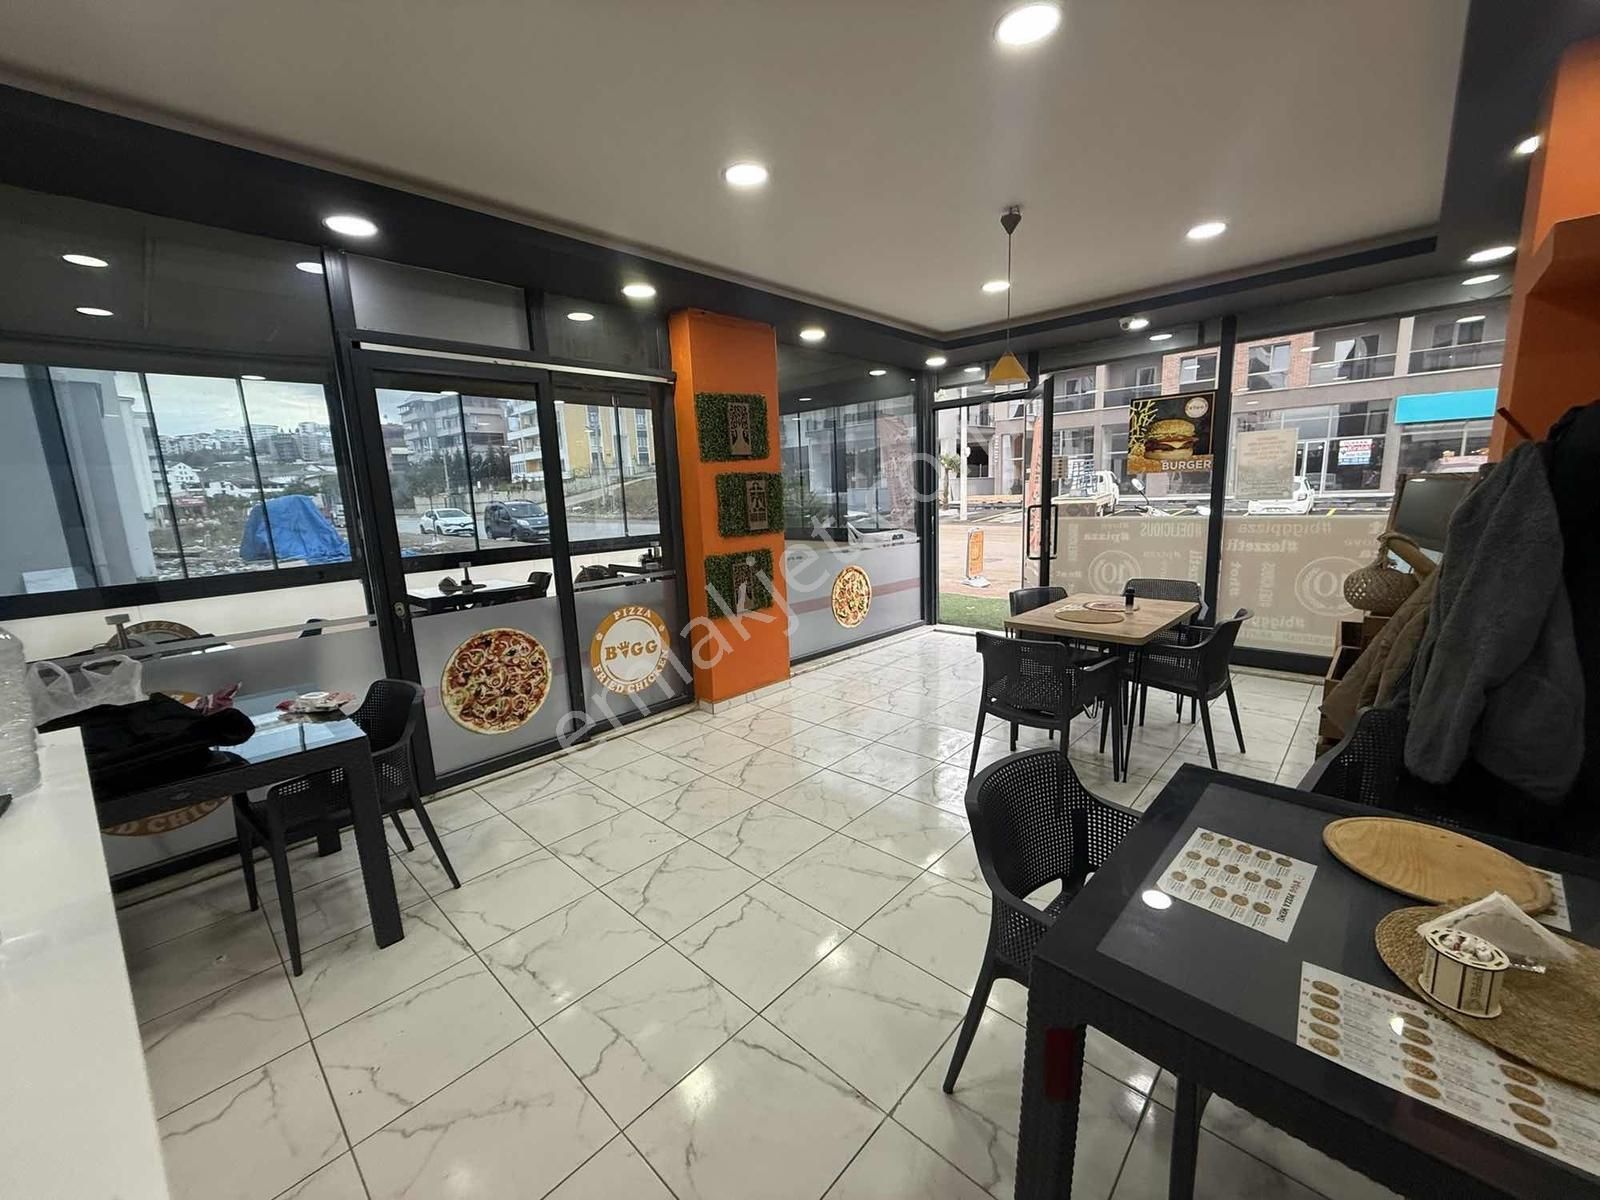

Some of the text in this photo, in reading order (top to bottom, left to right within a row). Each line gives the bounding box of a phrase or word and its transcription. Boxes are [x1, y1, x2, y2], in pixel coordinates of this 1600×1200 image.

[1161, 459, 1213, 472] BURGER
[613, 606, 652, 621] PIZZA
[592, 649, 670, 694] FRIED CHICKEN
